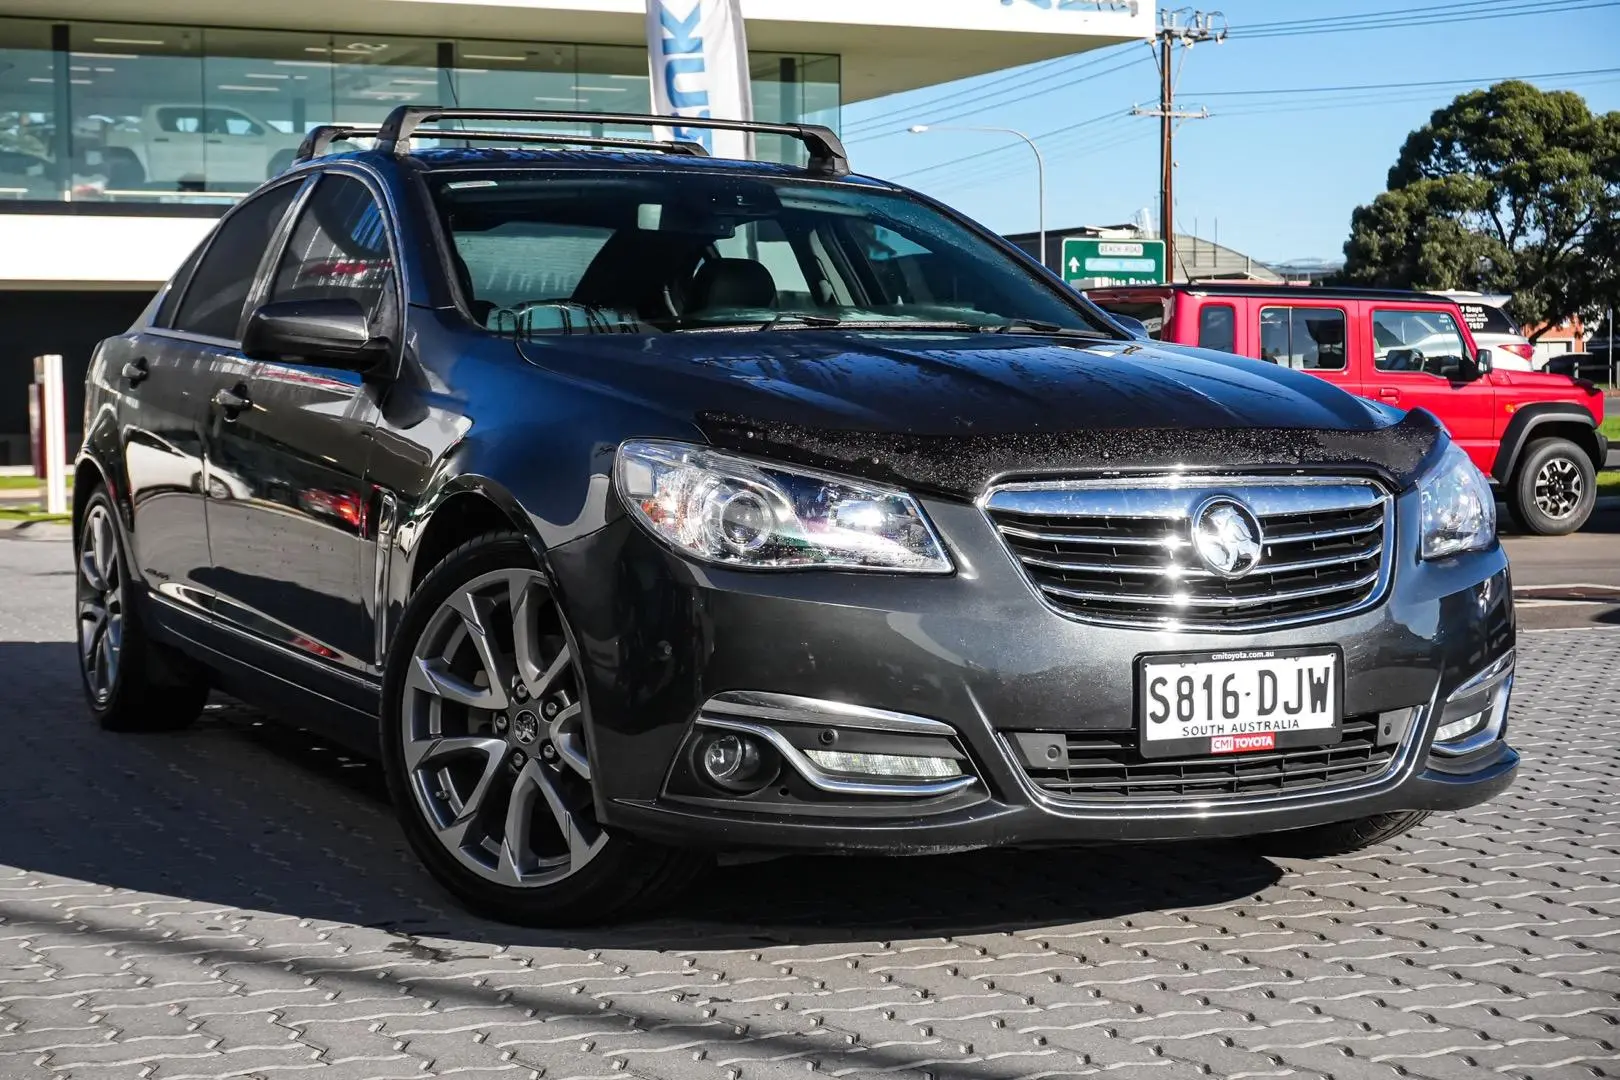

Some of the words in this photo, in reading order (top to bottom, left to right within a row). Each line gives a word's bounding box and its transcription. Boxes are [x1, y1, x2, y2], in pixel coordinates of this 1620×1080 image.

[1466, 306, 1483, 314] Days
[1212, 650, 1275, 660] cmitoyota.com.au
[1182, 724, 1225, 737] SOUTH
[1231, 719, 1300, 733] AUSTRALIA
[1213, 738, 1233, 750] CMI
[1234, 735, 1274, 749] TOYOTA
